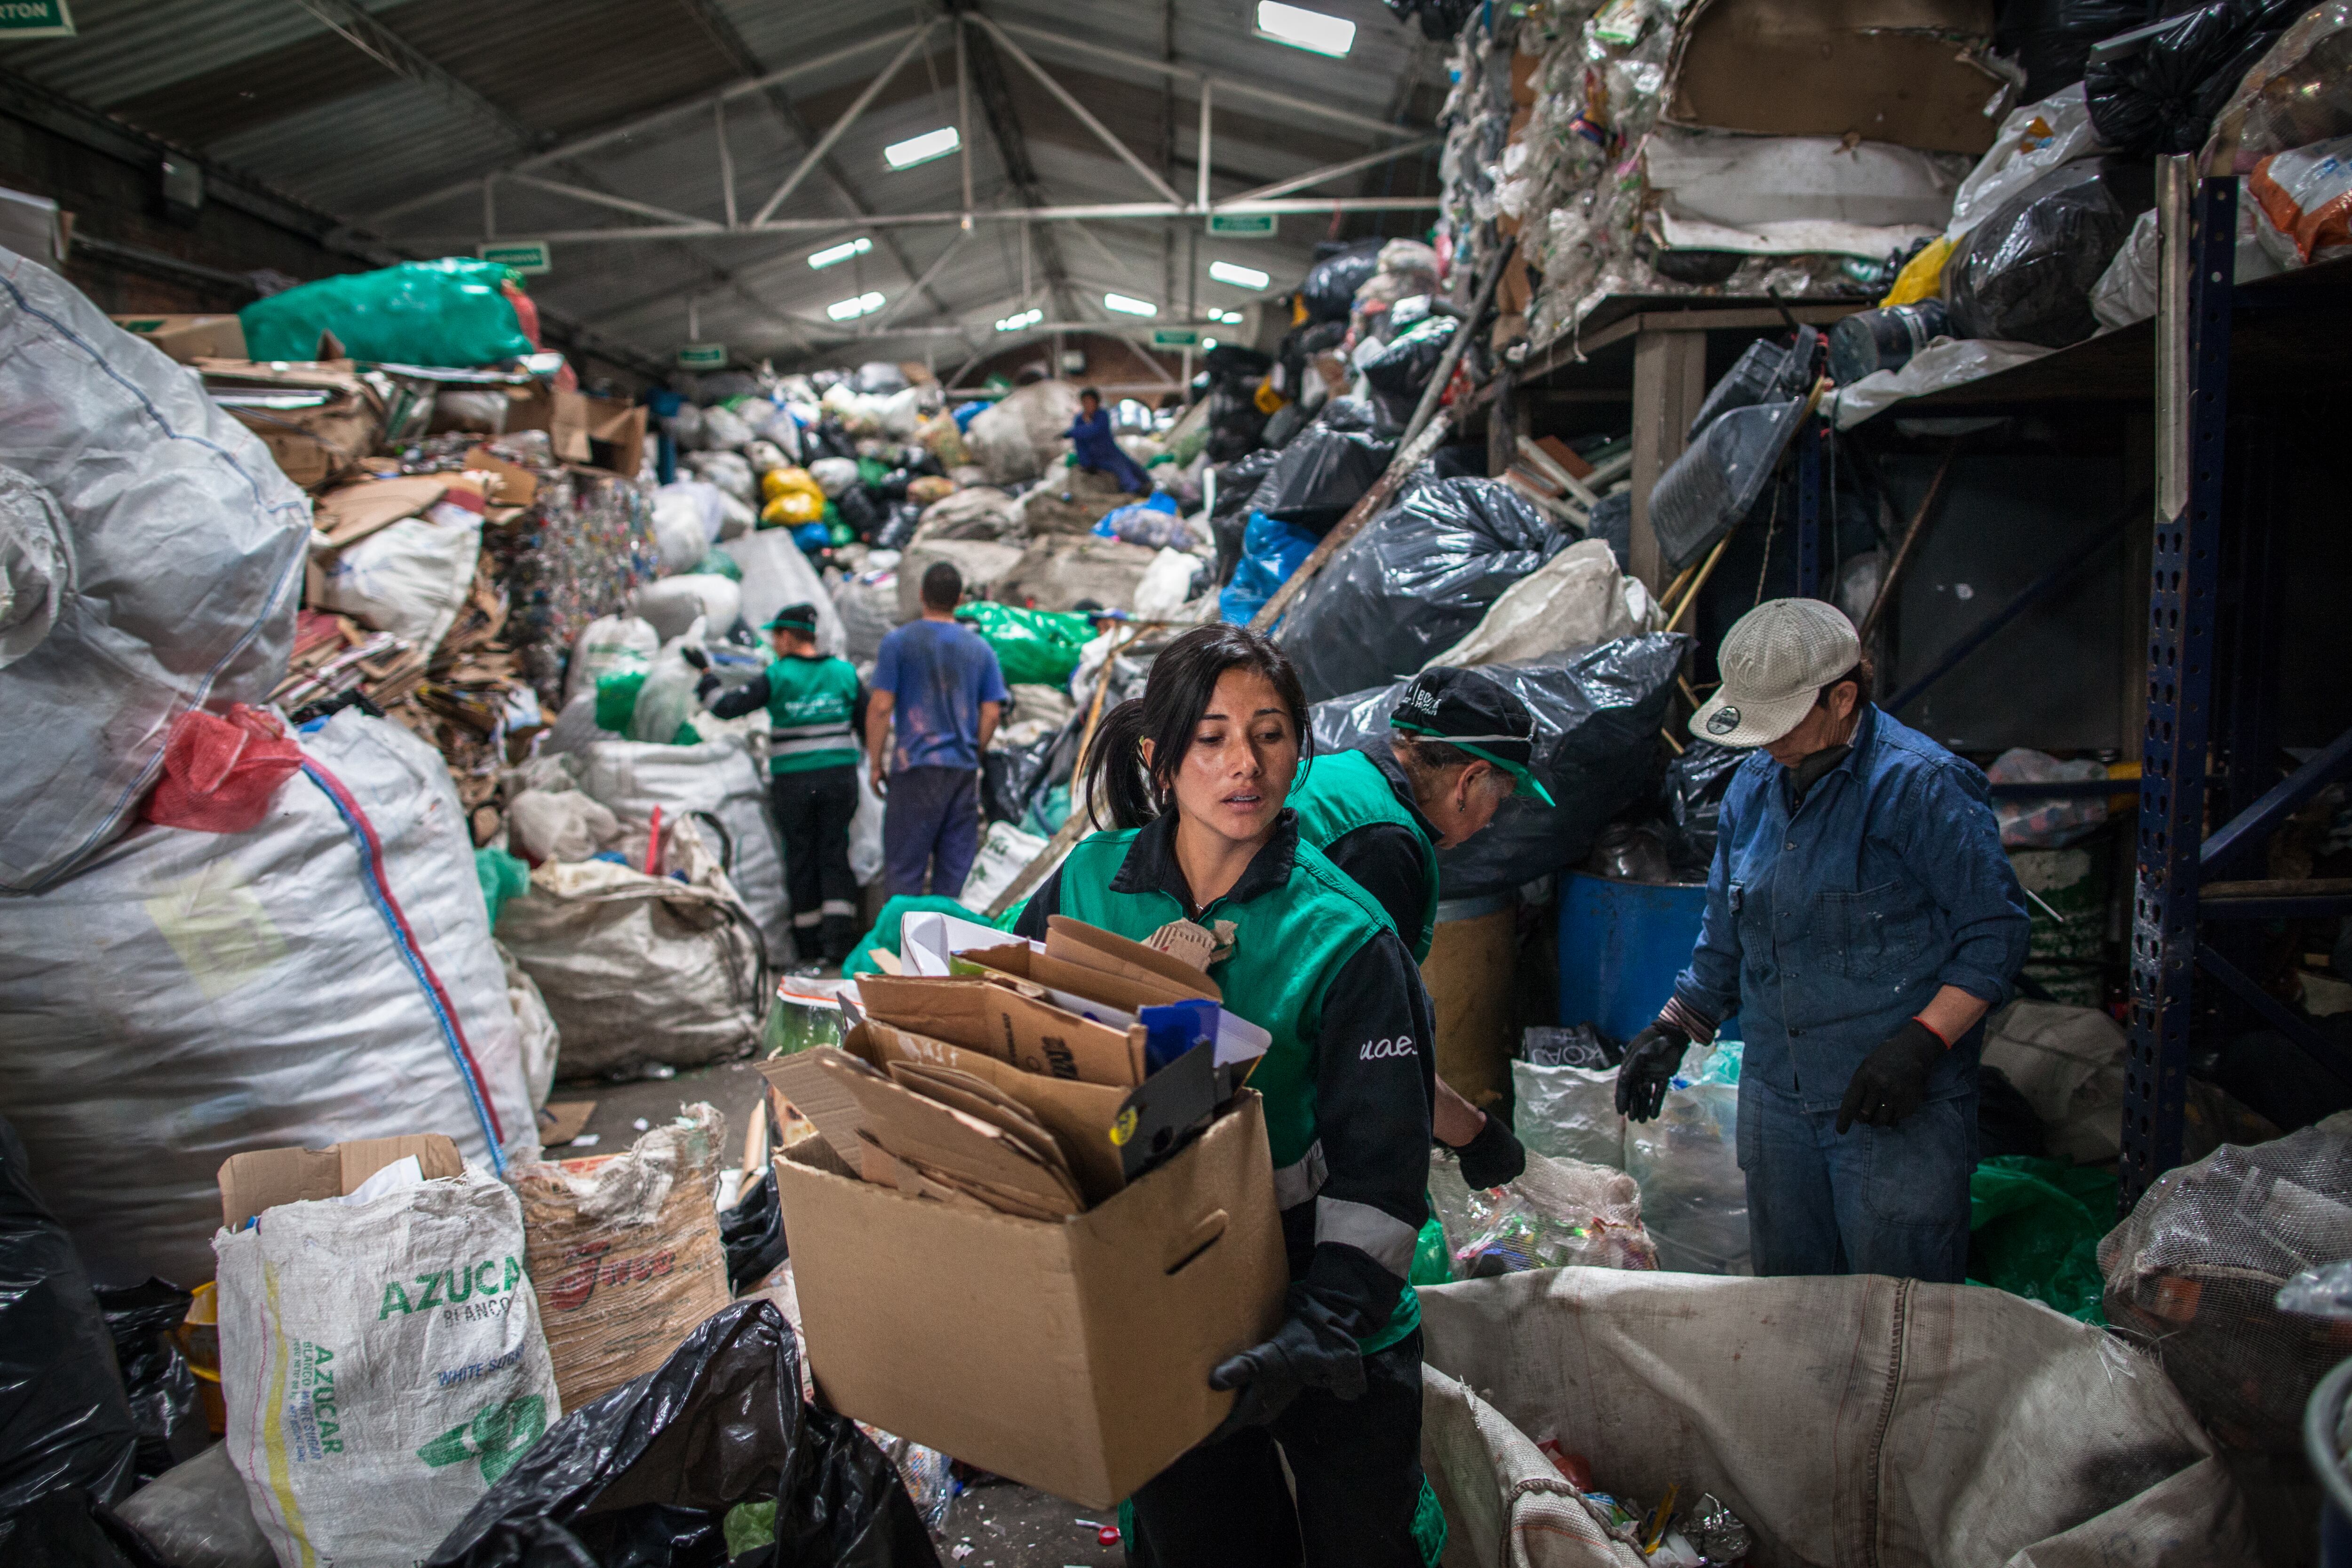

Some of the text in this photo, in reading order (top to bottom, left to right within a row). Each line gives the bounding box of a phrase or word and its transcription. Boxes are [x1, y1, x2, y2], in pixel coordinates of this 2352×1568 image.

[1359, 1035, 1418, 1060] uae
[302, 1341, 312, 1386] BLANCO
[438, 1363, 483, 1385] WHITE
[312, 1345, 344, 1454] AZUCAR
